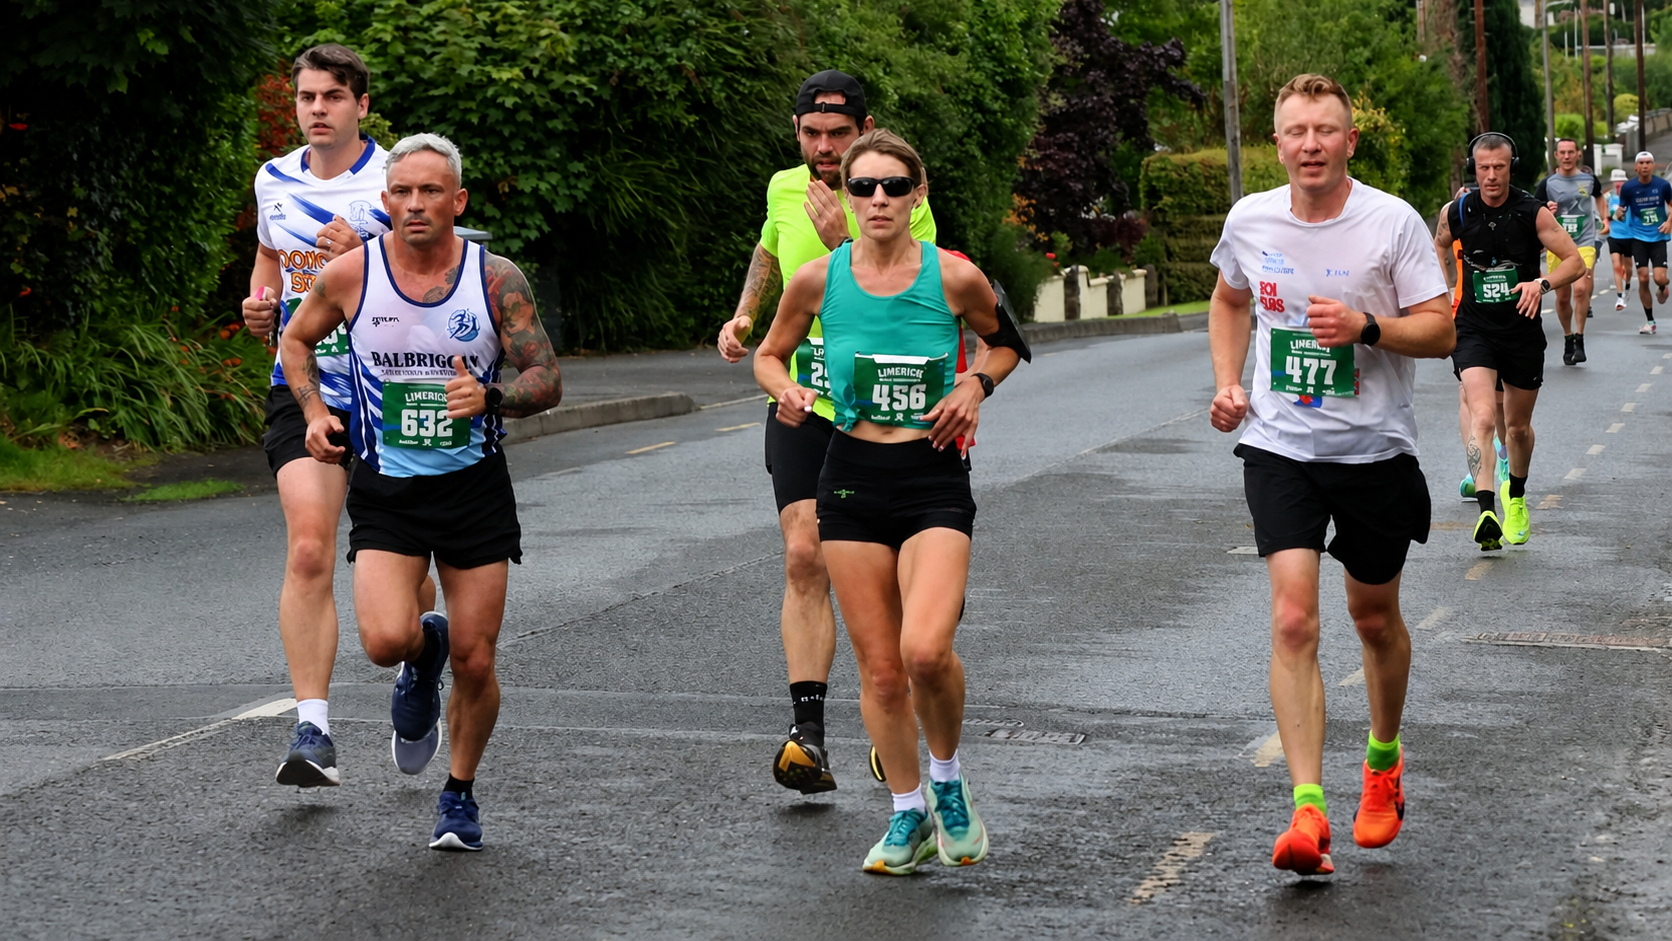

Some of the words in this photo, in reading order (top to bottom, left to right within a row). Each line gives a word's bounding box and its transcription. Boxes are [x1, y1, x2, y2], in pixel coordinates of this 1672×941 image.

[1483, 282, 1510, 298] 524
[1285, 355, 1337, 385] 477
[405, 391, 447, 402] LIMERIC
[872, 384, 927, 411] 456
[401, 408, 453, 437] 632
